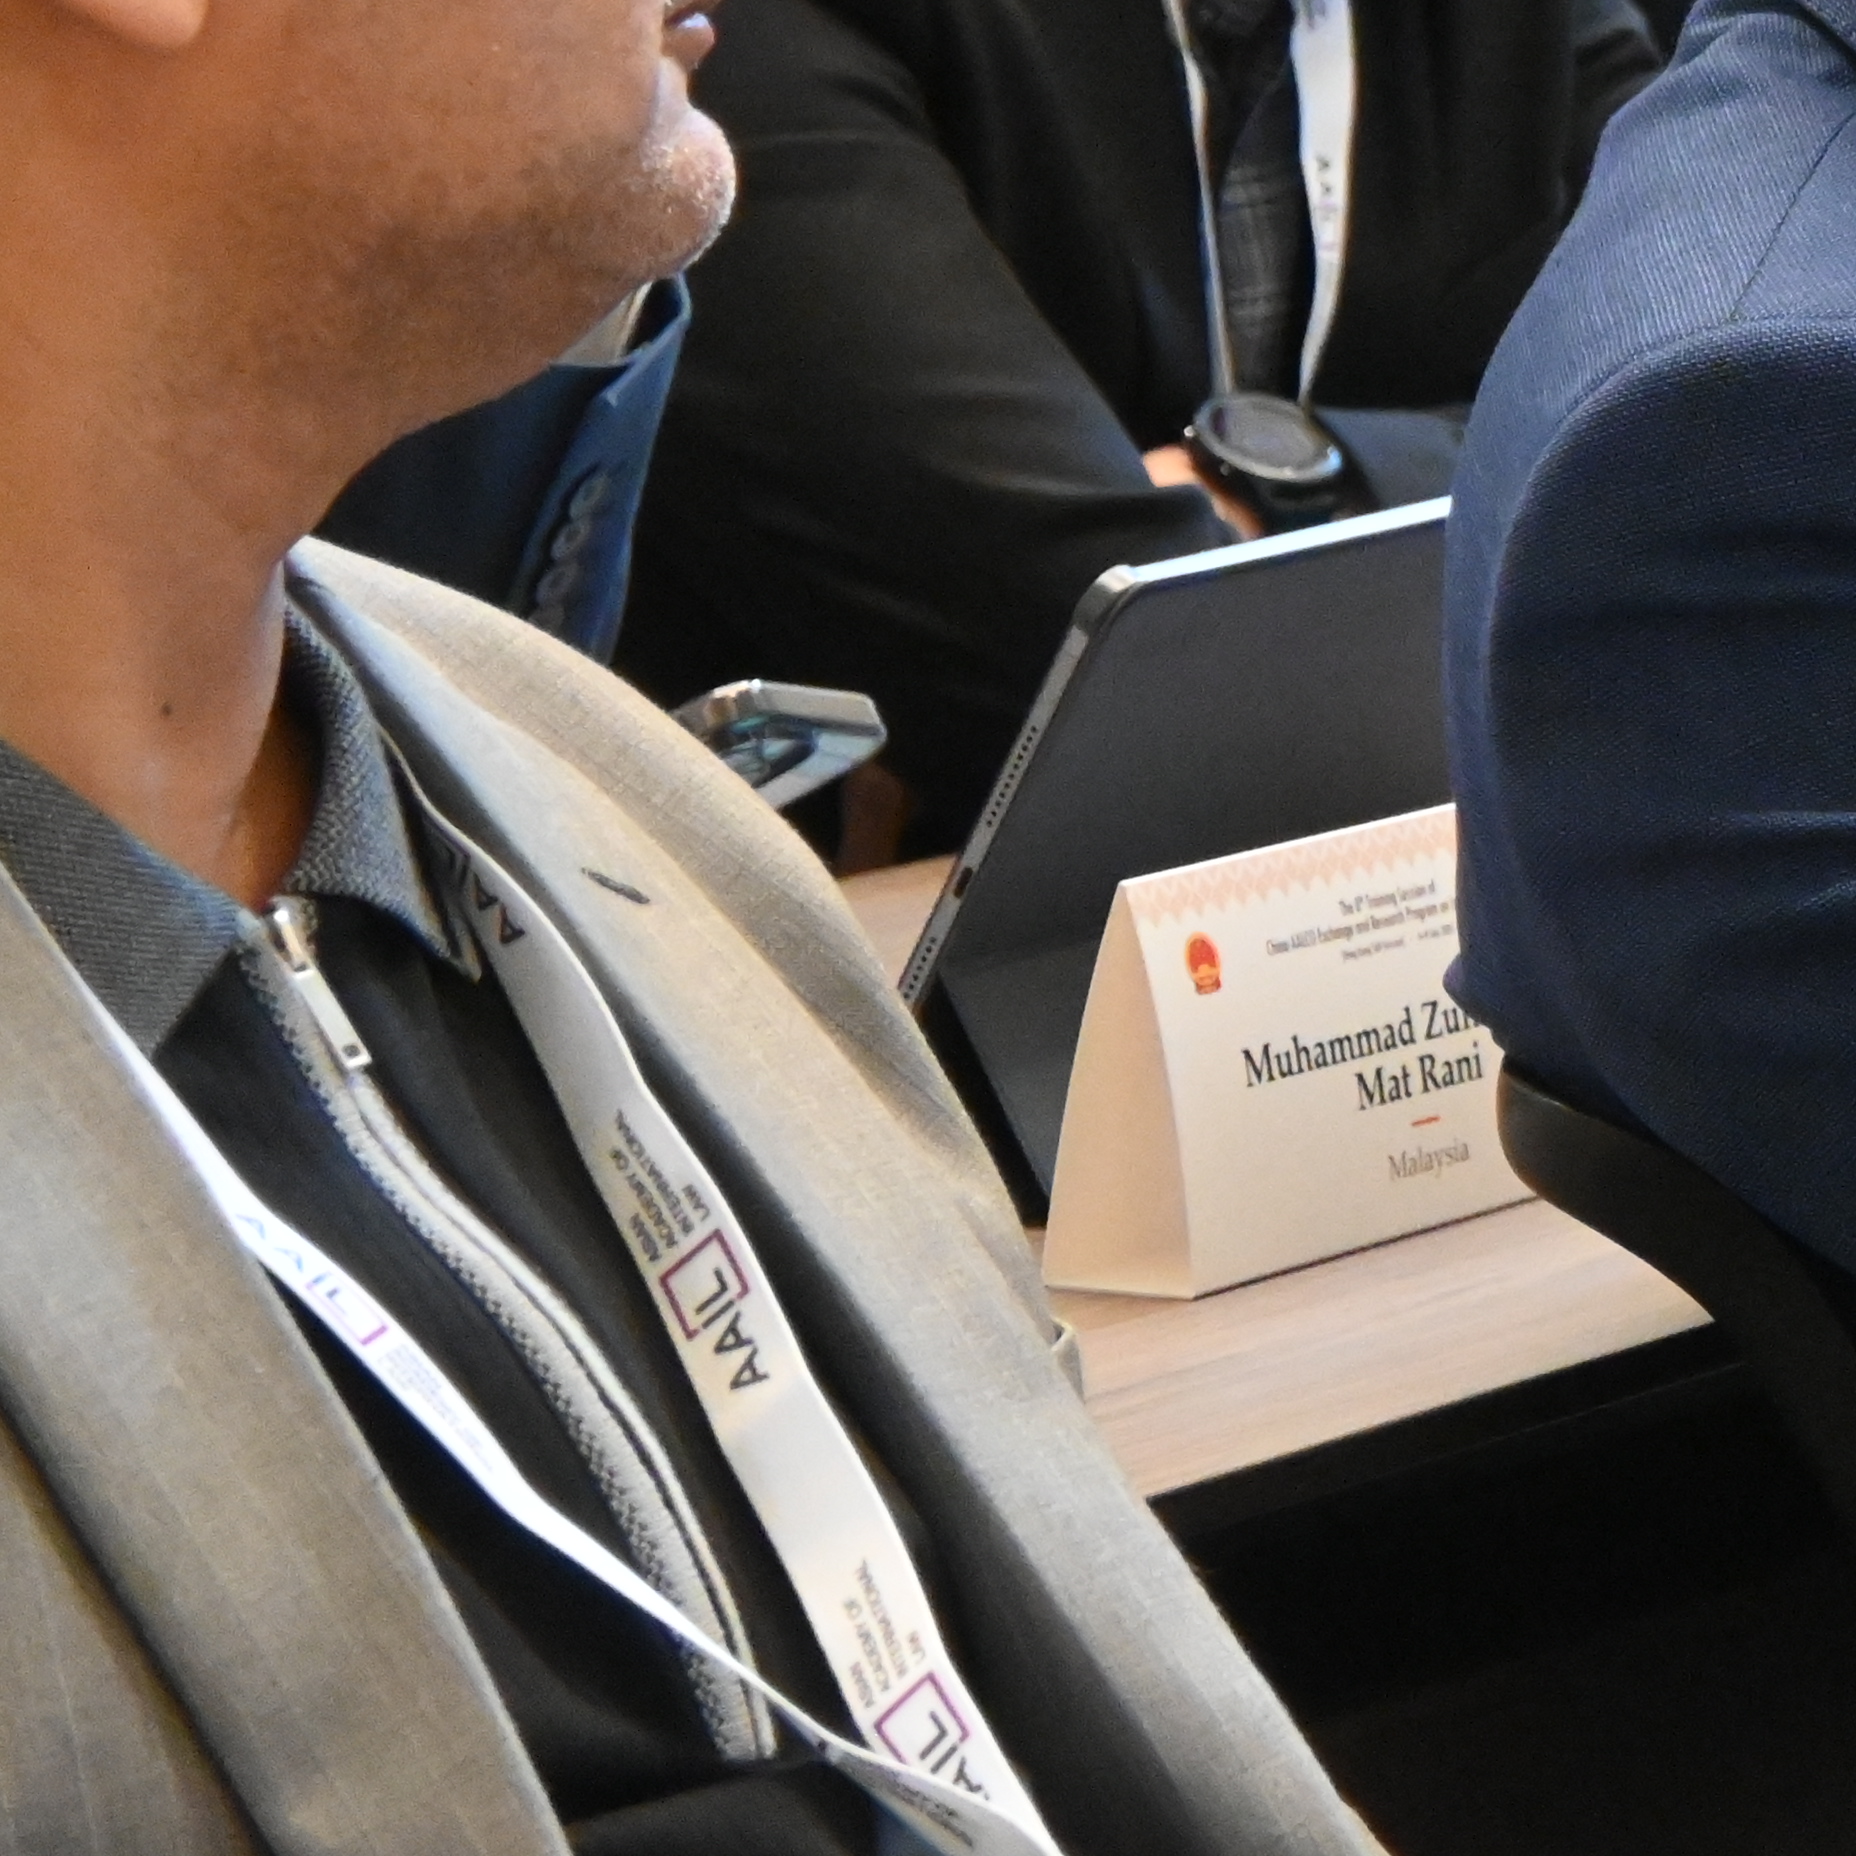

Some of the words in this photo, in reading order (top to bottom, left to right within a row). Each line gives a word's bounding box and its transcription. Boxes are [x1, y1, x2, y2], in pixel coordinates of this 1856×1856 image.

[1241, 1005, 1417, 1088] Muhammad
[1354, 1064, 1413, 1111] Mat
[1418, 1040, 1484, 1095] Rani
[1387, 1139, 1471, 1182] Malaysia
[625, 1172, 679, 1250] ACADEMY
[629, 1211, 662, 1263] ASIAN
[681, 1183, 711, 1223] LAW
[693, 1266, 770, 1390] AAIL
[919, 1710, 990, 1801] AIL
